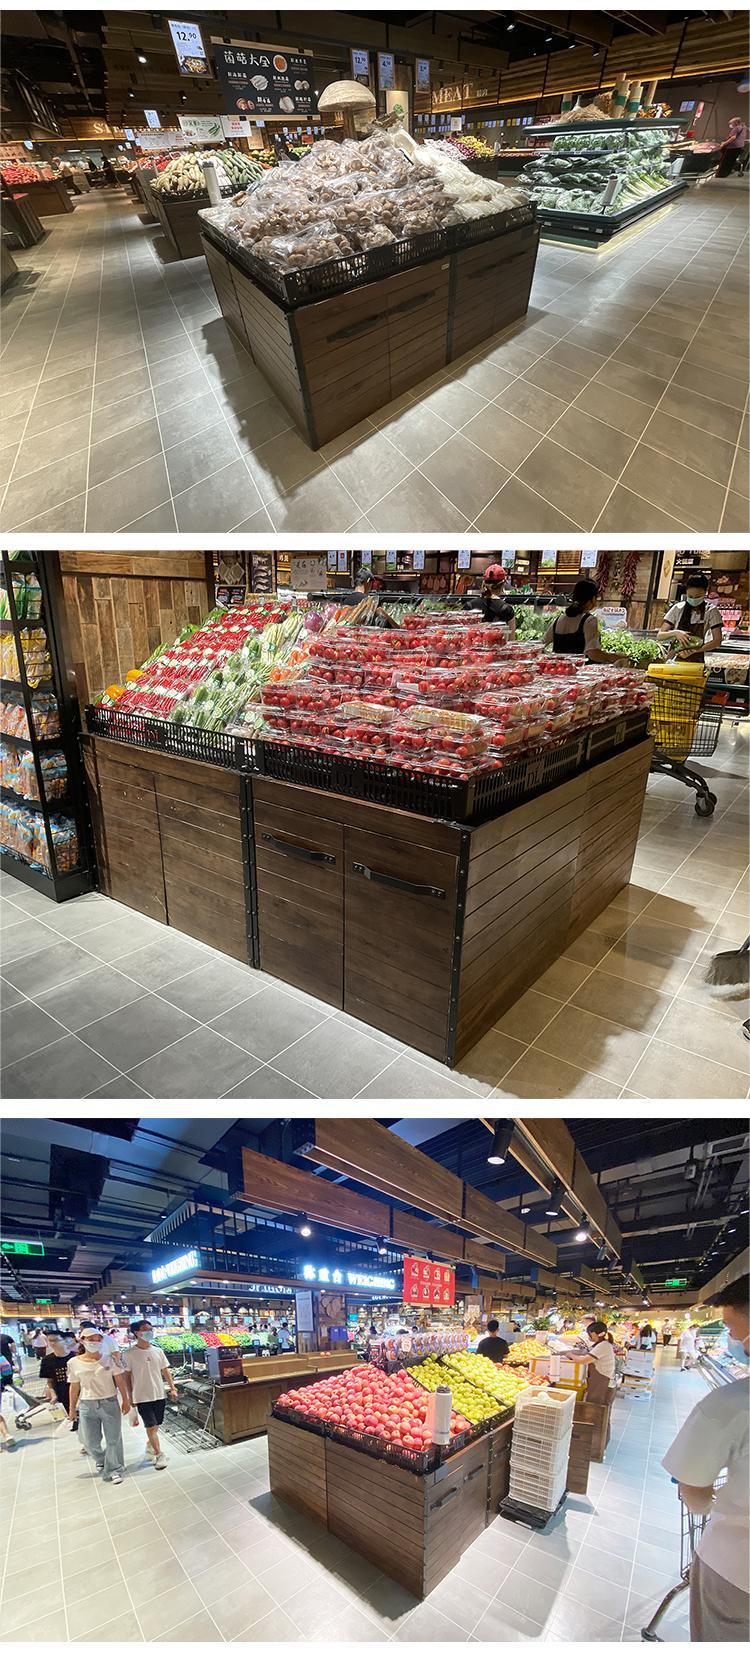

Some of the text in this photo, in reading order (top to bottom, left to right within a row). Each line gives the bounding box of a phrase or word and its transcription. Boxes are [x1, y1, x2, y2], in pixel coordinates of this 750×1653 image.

[176, 31, 197, 42] 12.90
[224, 50, 270, 68] 菌菇大全
[431, 82, 474, 105] MEAT
